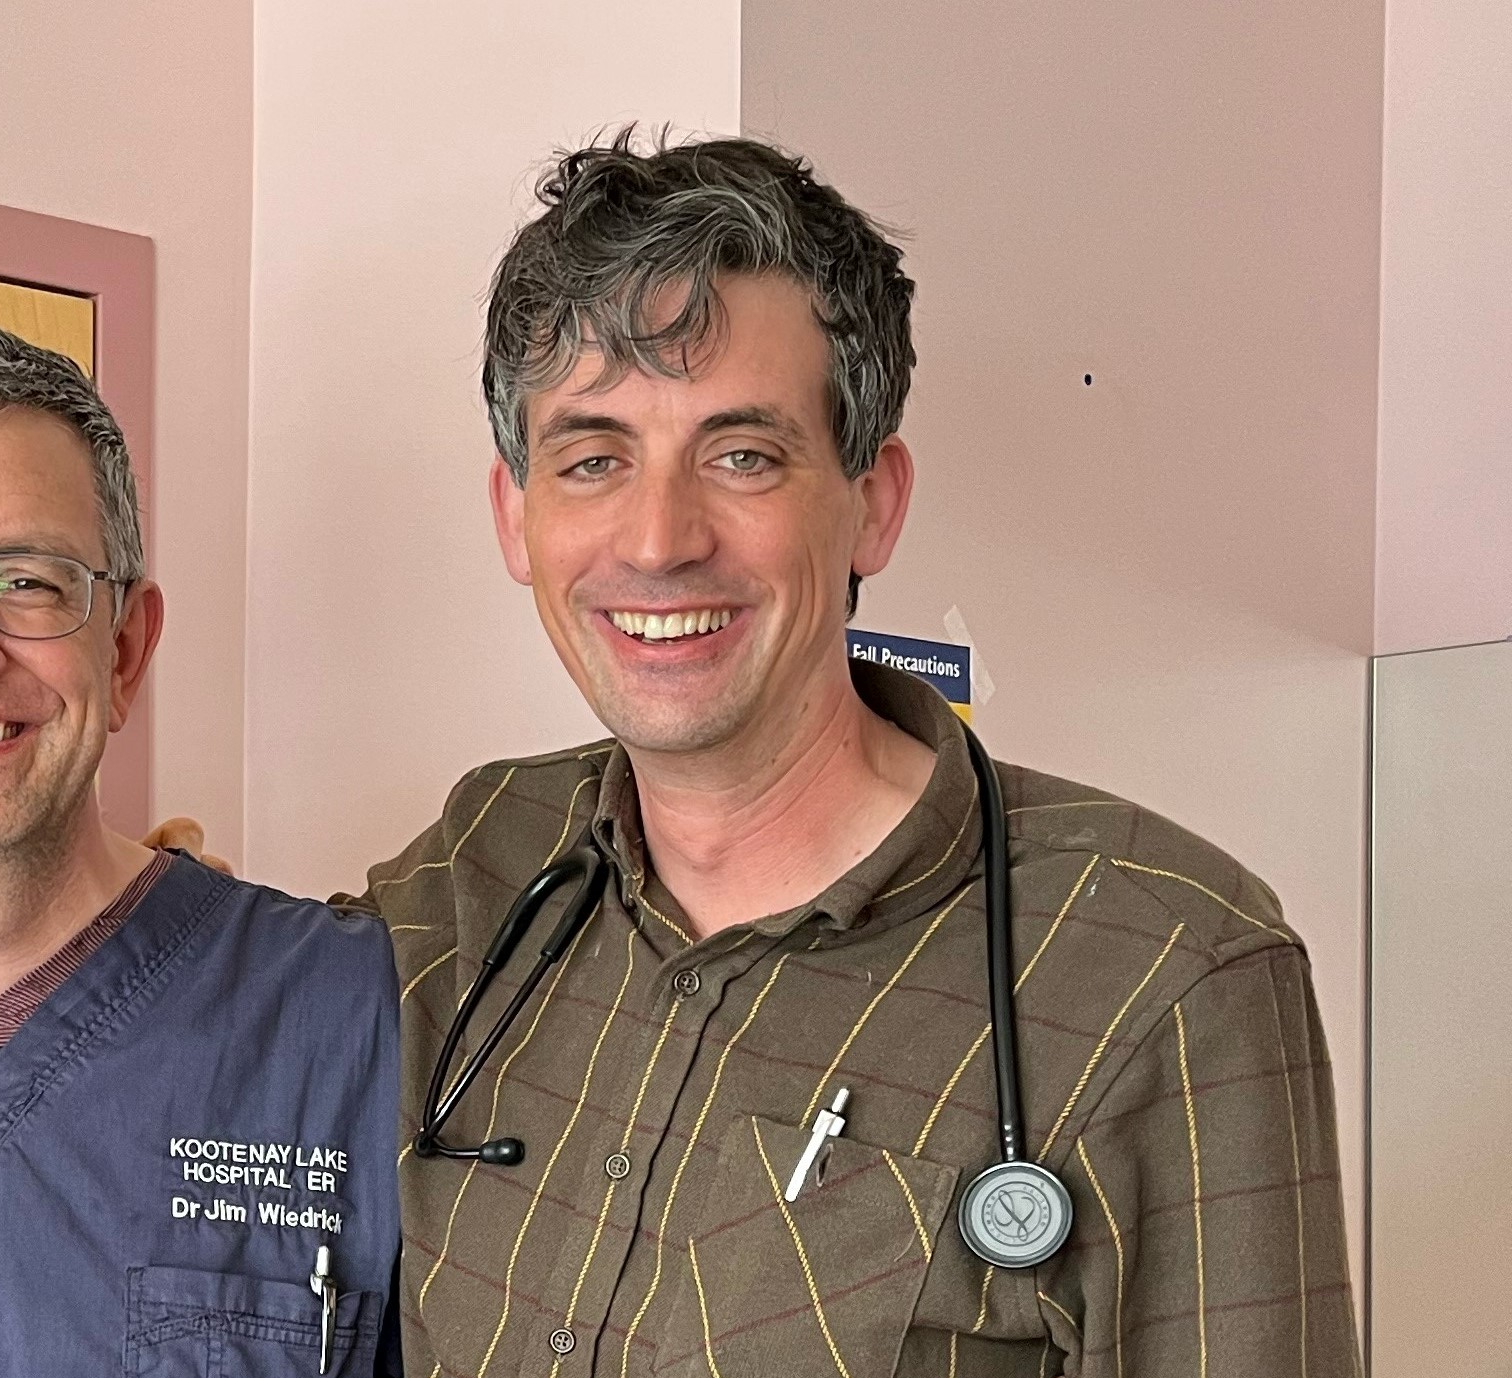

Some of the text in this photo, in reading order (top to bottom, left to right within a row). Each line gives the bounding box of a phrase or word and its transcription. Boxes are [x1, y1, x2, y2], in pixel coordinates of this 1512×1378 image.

[853, 643, 960, 678] Fall Precautions
[170, 1138, 348, 1173] KOOTENAY LAKE
[183, 1161, 336, 1193] HOSPITAL ER
[171, 1197, 201, 1219] Dr
[204, 1199, 247, 1223] Jim
